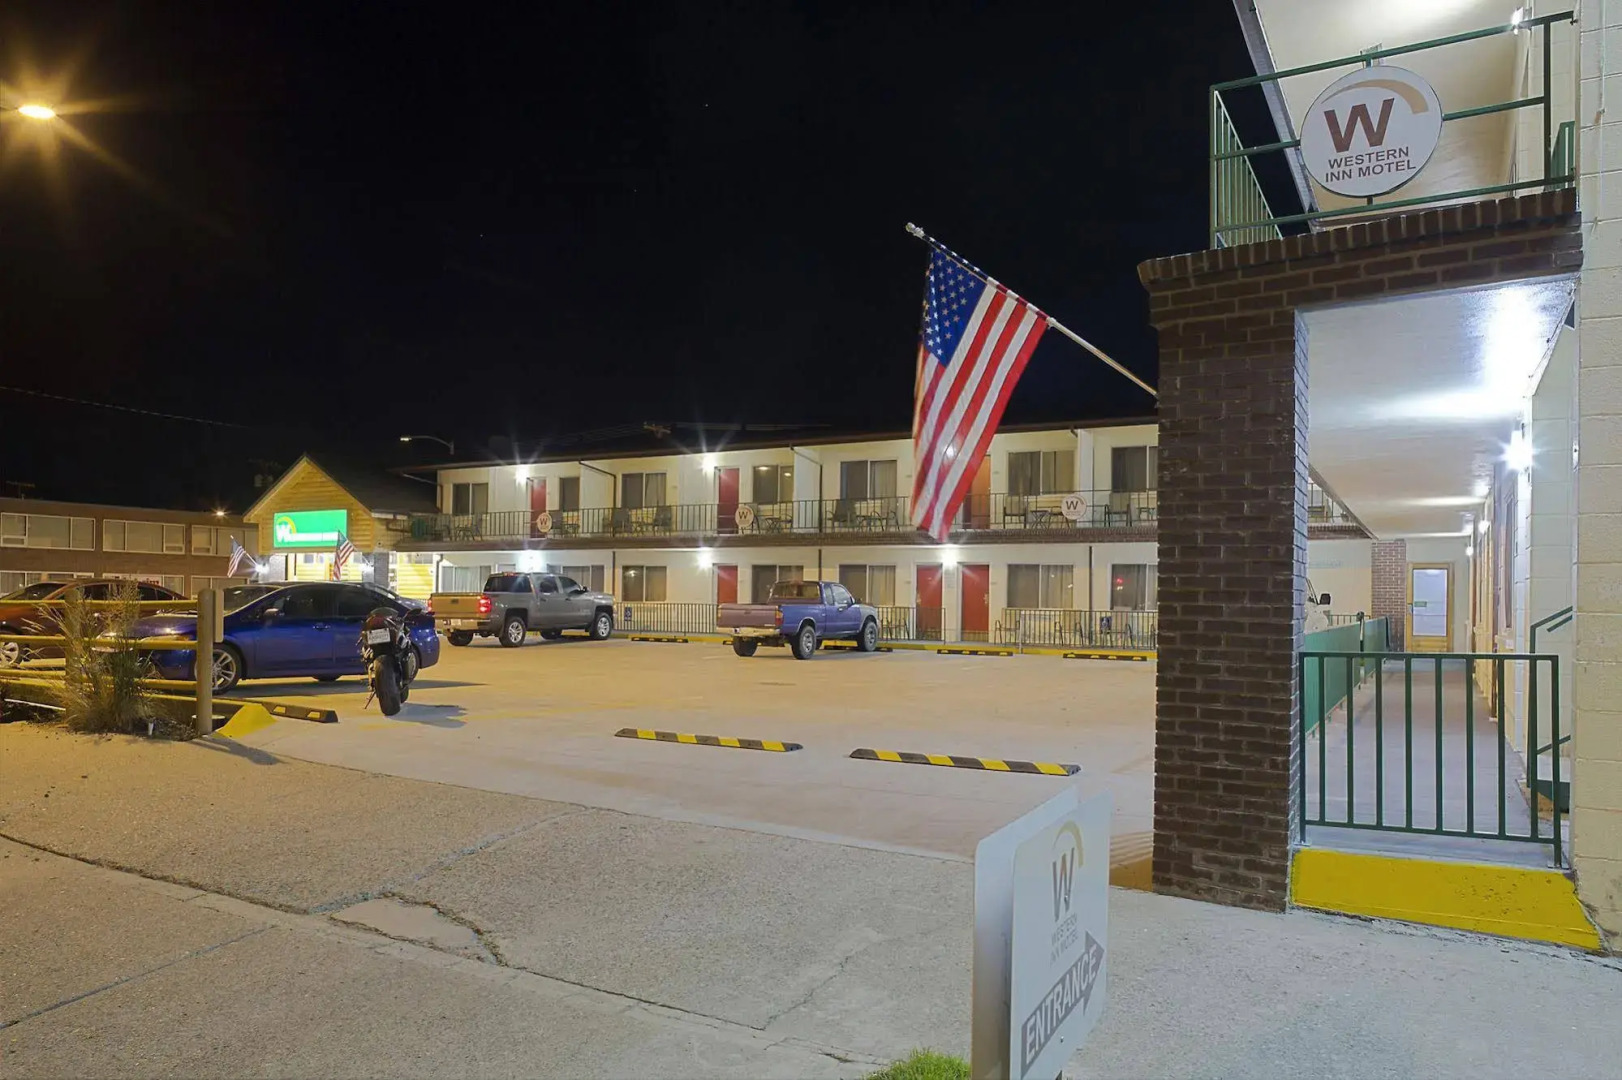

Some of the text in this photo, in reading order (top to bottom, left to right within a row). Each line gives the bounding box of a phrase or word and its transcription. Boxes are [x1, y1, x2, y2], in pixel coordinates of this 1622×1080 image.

[1324, 98, 1395, 153] W
[1325, 159, 1416, 183] INN MOTEL
[1328, 146, 1409, 170] WESTERN
[1066, 500, 1078, 510] W
[1052, 847, 1075, 923] W
[1026, 944, 1097, 1065] ENTRANCE
